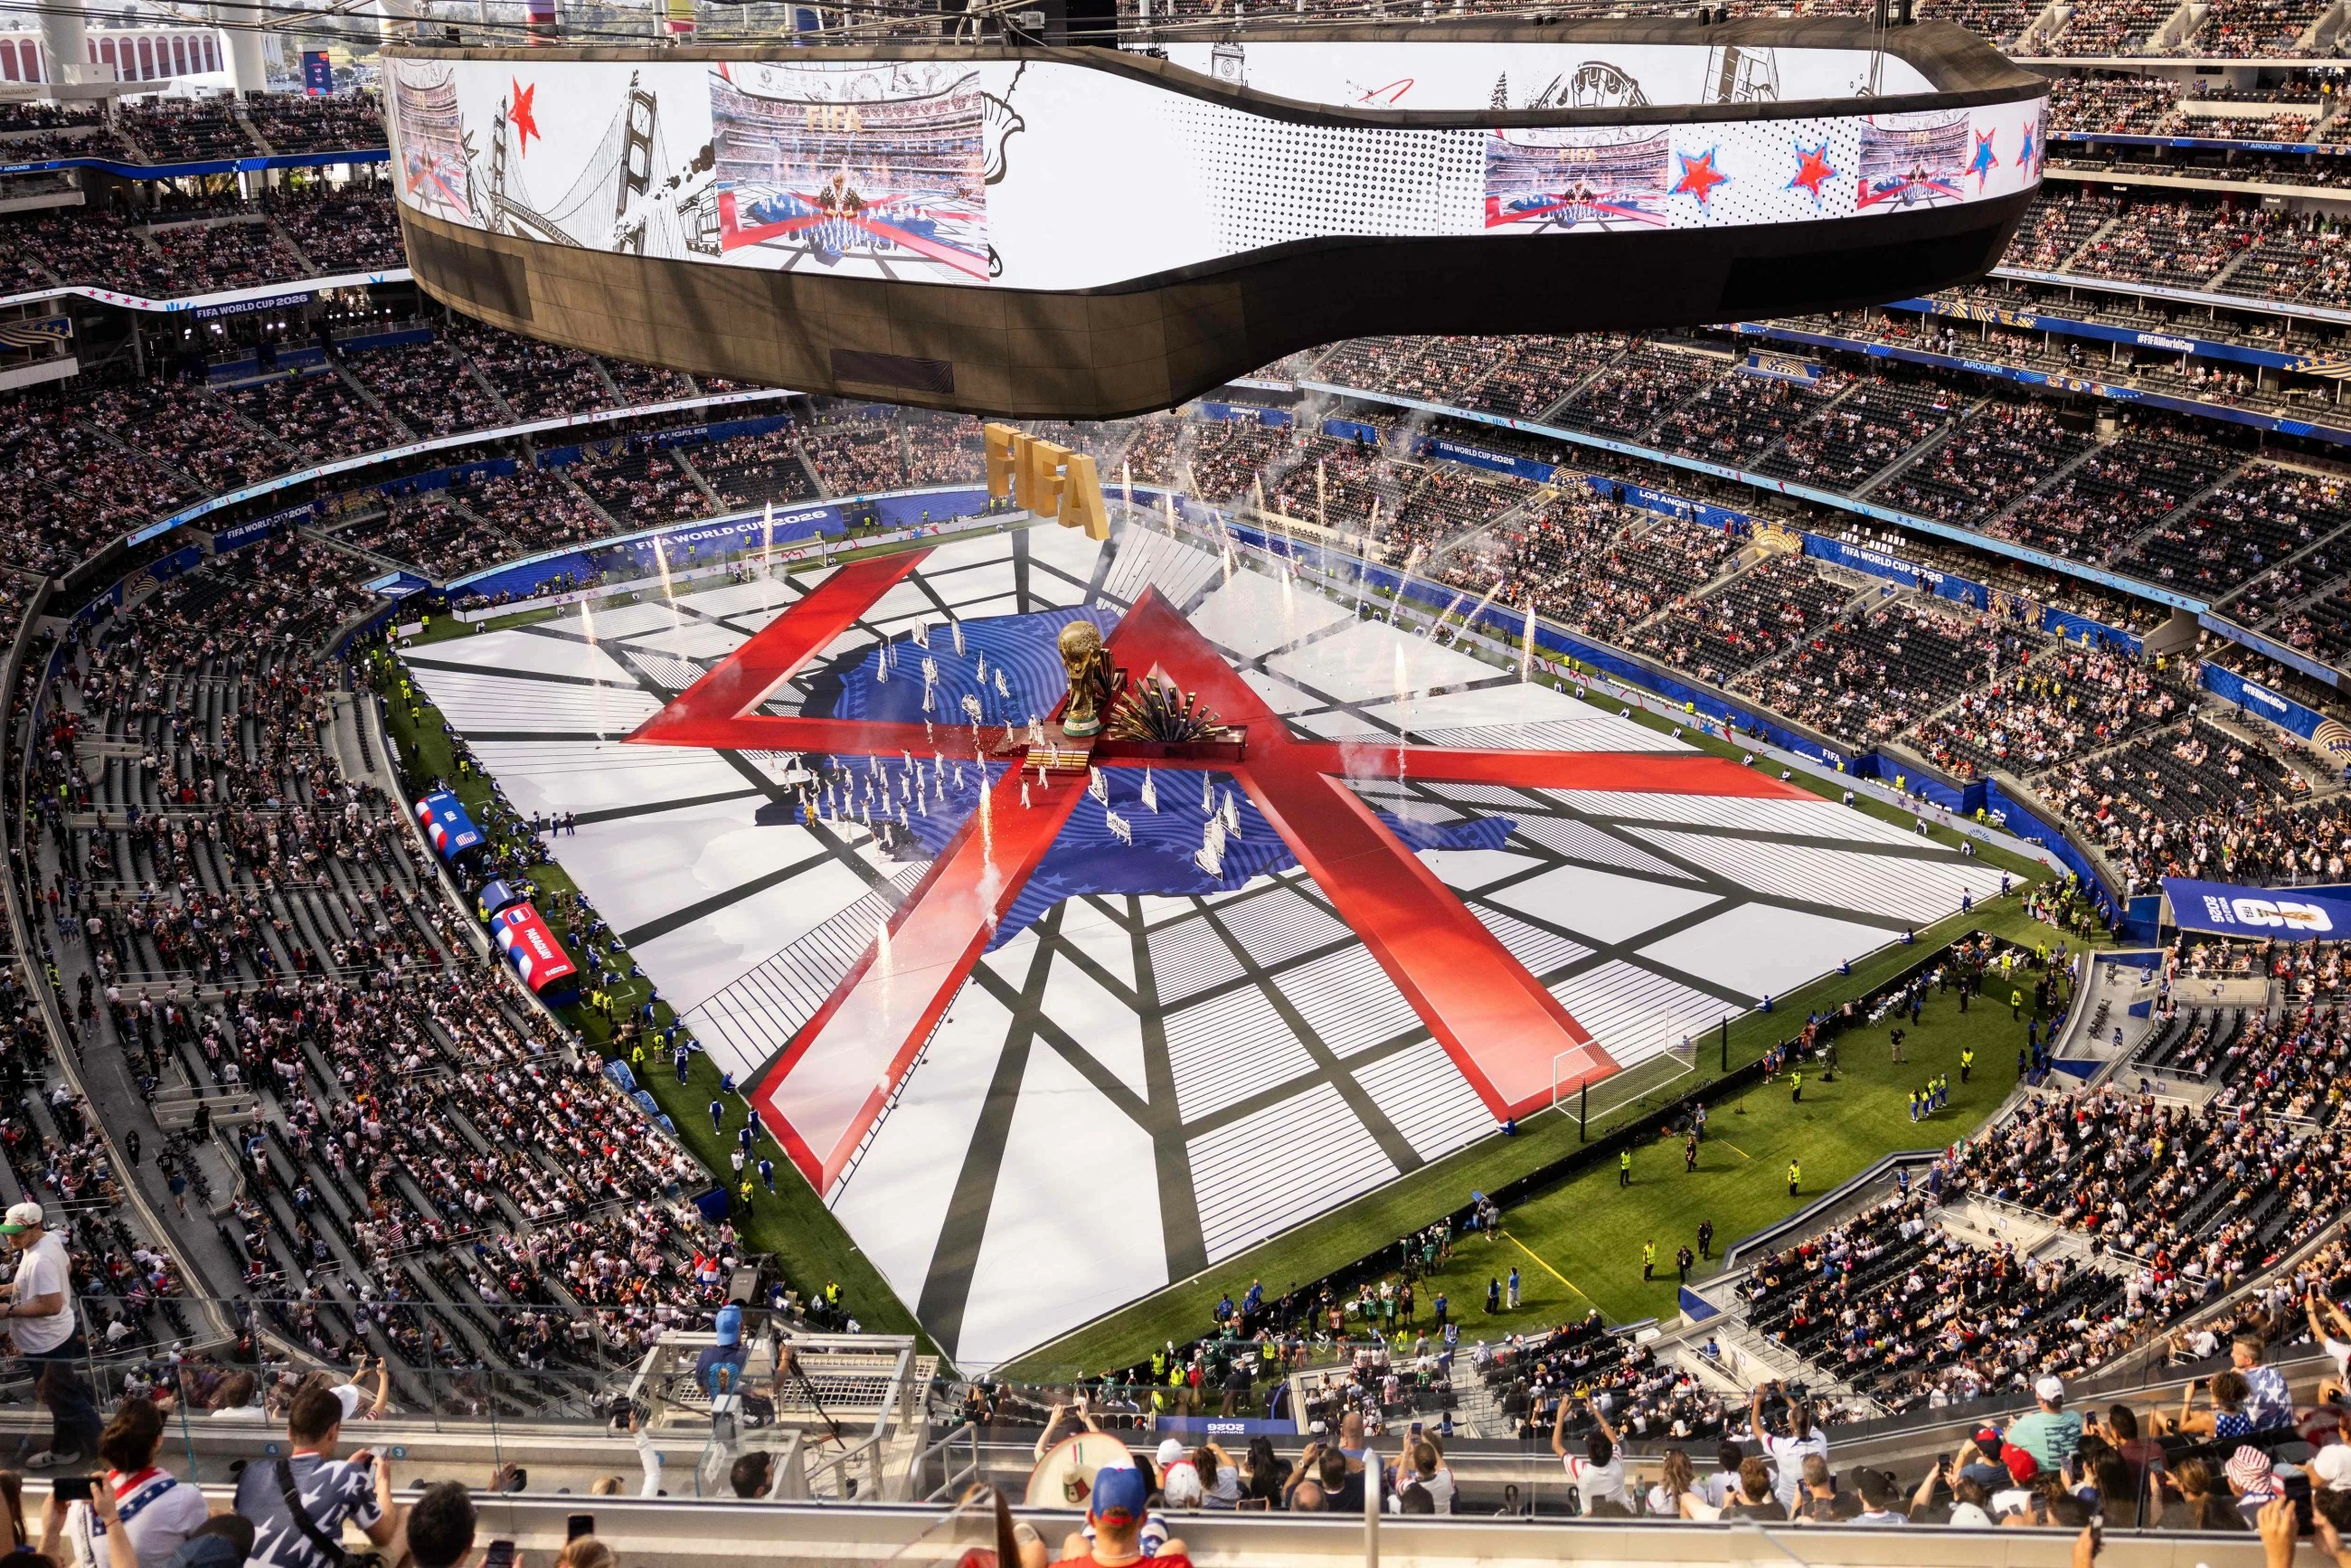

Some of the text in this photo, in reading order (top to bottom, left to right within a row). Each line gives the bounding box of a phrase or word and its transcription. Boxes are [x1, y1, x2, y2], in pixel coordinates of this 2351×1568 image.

[807, 105, 863, 132] FIFA
[196, 294, 307, 318] FIFA WORLD CUP 2026
[2137, 333, 2195, 353] #FIFAWorldCup
[1963, 360, 2003, 374] AROUND!
[1440, 442, 1515, 466] FIFA WORLD CUP 2026
[985, 422, 1110, 541] FIFA
[1638, 489, 1706, 514] LOS ANGELES
[226, 528, 245, 540] FIFA
[636, 536, 675, 550] FIA
[673, 526, 734, 543] WORLD
[770, 510, 828, 526] 2026
[1841, 545, 1860, 559] FIFA
[1860, 551, 1893, 568] WORLD
[1893, 561, 1912, 572] CUP
[2242, 683, 2288, 713] #FIFAWorldCup
[1822, 748, 1840, 762] FIFA
[2203, 895, 2225, 922] 2026
[524, 927, 554, 960] PARAGUAY
